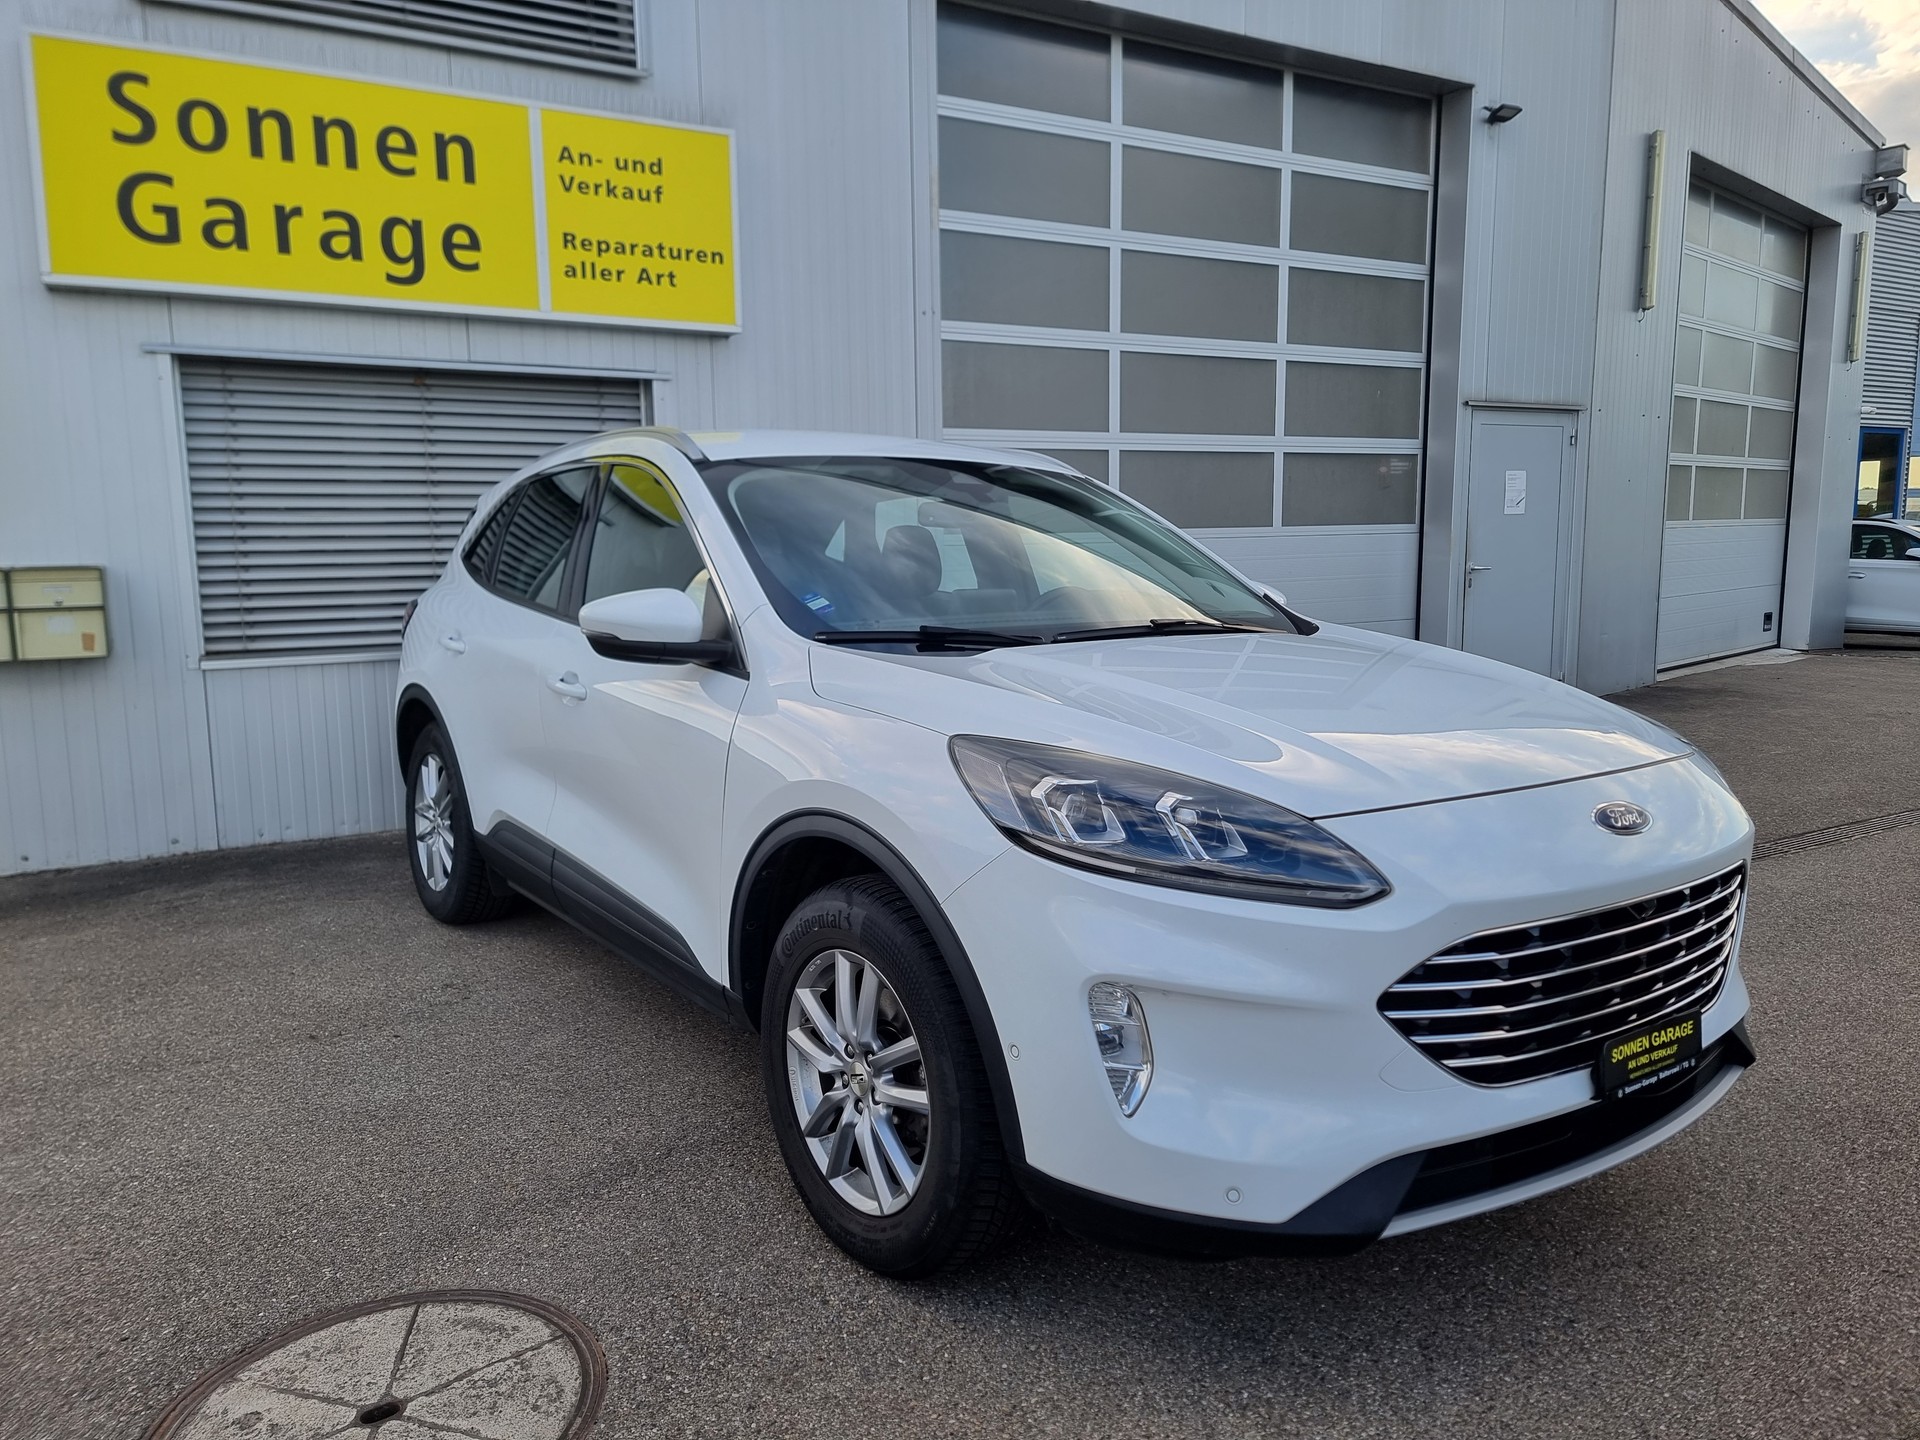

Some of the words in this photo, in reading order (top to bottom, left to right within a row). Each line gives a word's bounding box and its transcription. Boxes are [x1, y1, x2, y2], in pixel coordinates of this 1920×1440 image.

[106, 70, 476, 185] Sonnen
[558, 145, 604, 167] An-
[614, 157, 663, 177] und
[558, 174, 664, 204] Verkauf
[115, 171, 482, 287] Garage
[562, 231, 724, 265] Reparaturen
[564, 260, 625, 283] aller
[636, 267, 677, 288] Art
[1607, 807, 1643, 827] Ford
[781, 909, 842, 958] Continental
[1611, 1034, 1650, 1063] SONNEN
[1651, 1020, 1694, 1046] GARAGE
[1627, 1059, 1637, 1070] AN
[1637, 1053, 1650, 1066] UND
[1650, 1044, 1679, 1061] VERKAUF
